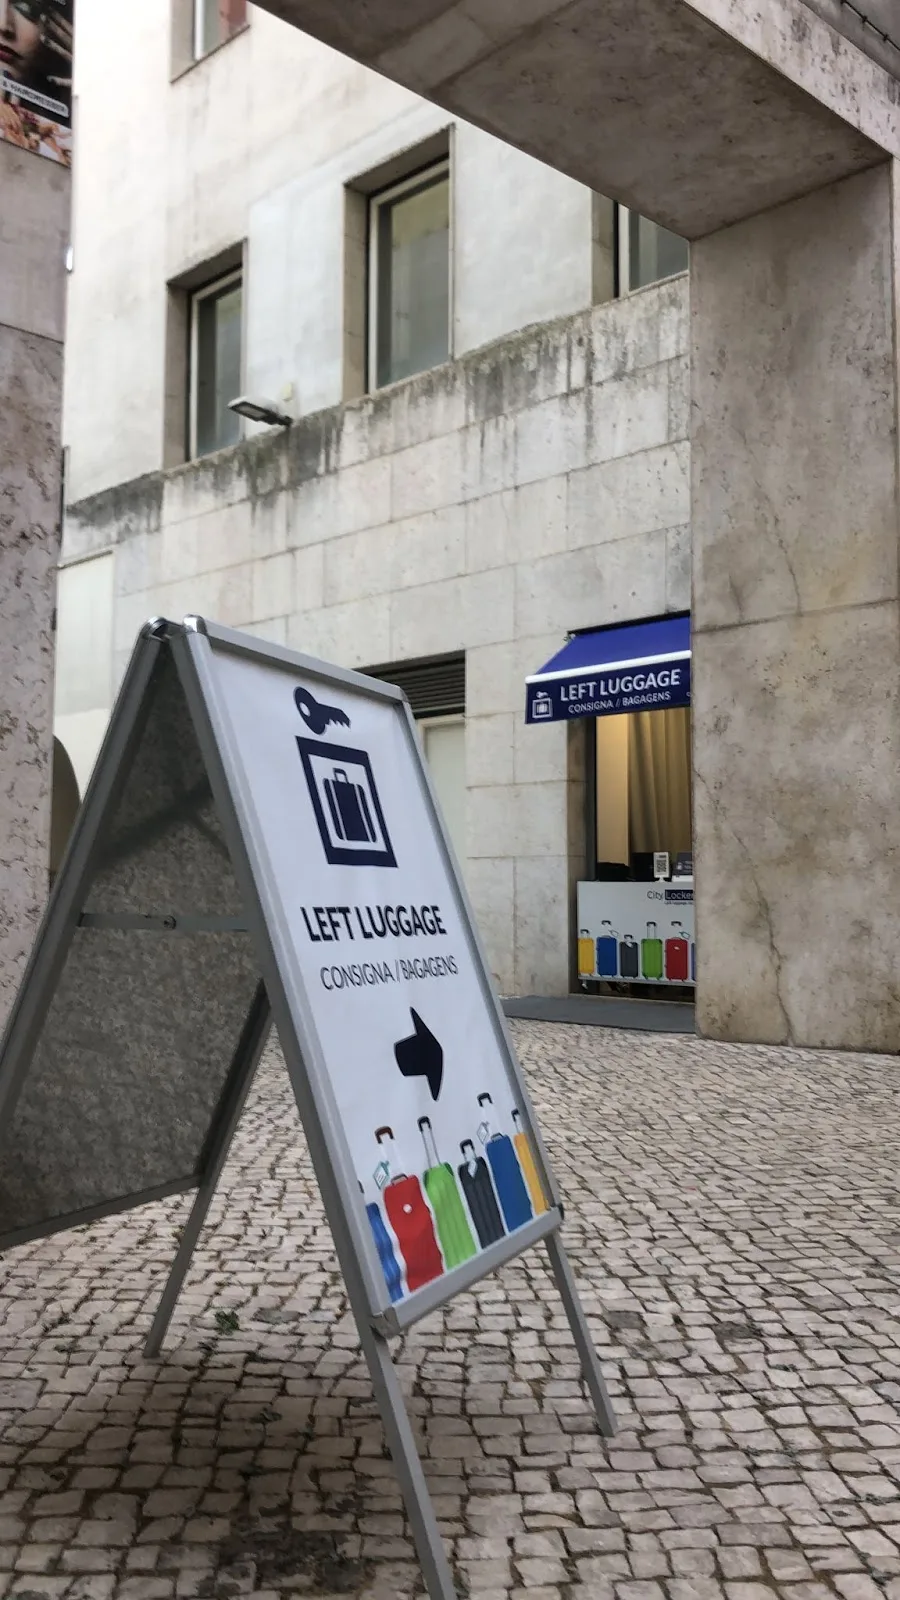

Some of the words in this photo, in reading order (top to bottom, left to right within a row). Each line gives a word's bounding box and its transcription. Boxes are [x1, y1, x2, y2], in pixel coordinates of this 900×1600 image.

[560, 681, 597, 701] LEFT
[600, 669, 681, 696] LUGGAGE
[568, 699, 614, 714] CONSIGNA
[622, 691, 671, 706] BAGAGENS
[646, 890, 664, 901] City
[300, 906, 355, 942] LEFT
[354, 904, 448, 939] LUGGAGE
[320, 960, 395, 991] CONSIGNA
[394, 959, 401, 983] /
[399, 955, 459, 981] BAGAGENS
